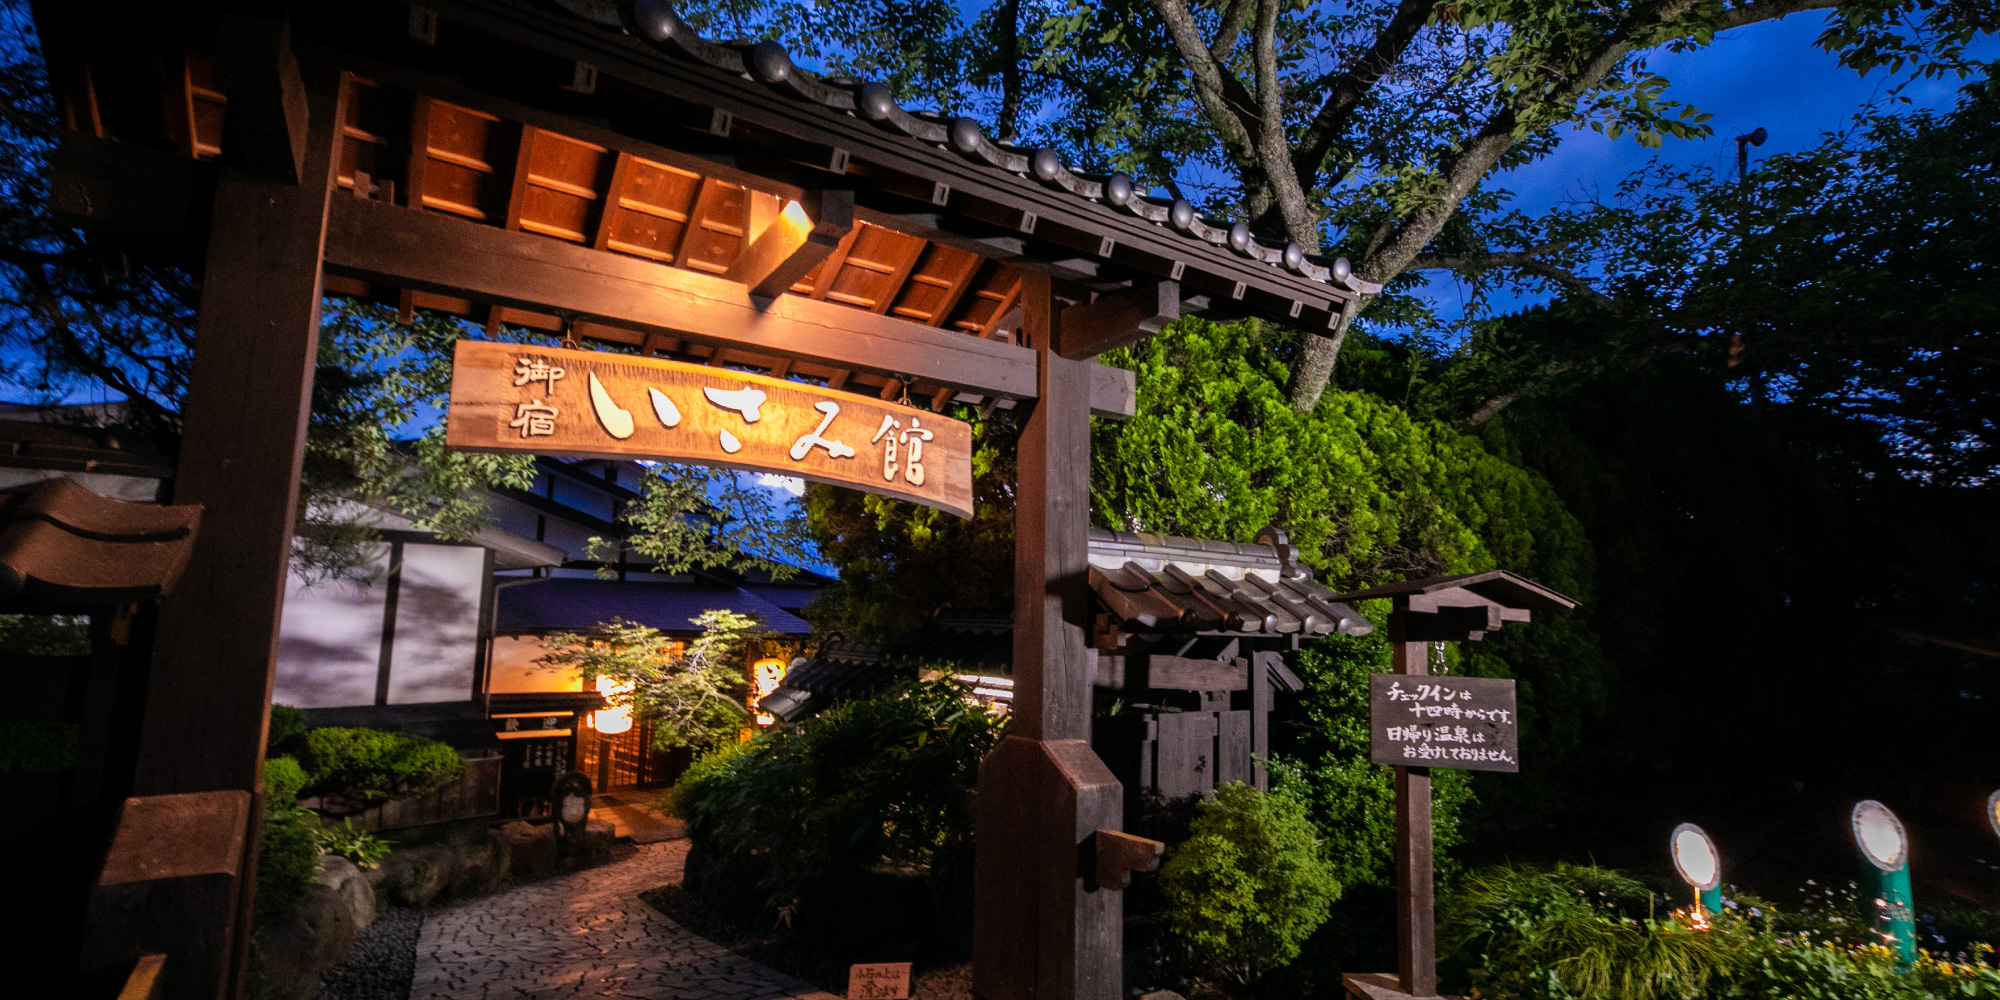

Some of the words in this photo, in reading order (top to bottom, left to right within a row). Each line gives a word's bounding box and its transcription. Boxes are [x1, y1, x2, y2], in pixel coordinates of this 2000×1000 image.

[589, 371, 933, 486] いさみ館
[1387, 681, 1472, 702] チェックインは
[1409, 702, 1512, 725] 十四時からです。
[1386, 725, 1486, 744] 日帰り温泉は
[1403, 743, 1515, 765] お受けしておりません。
